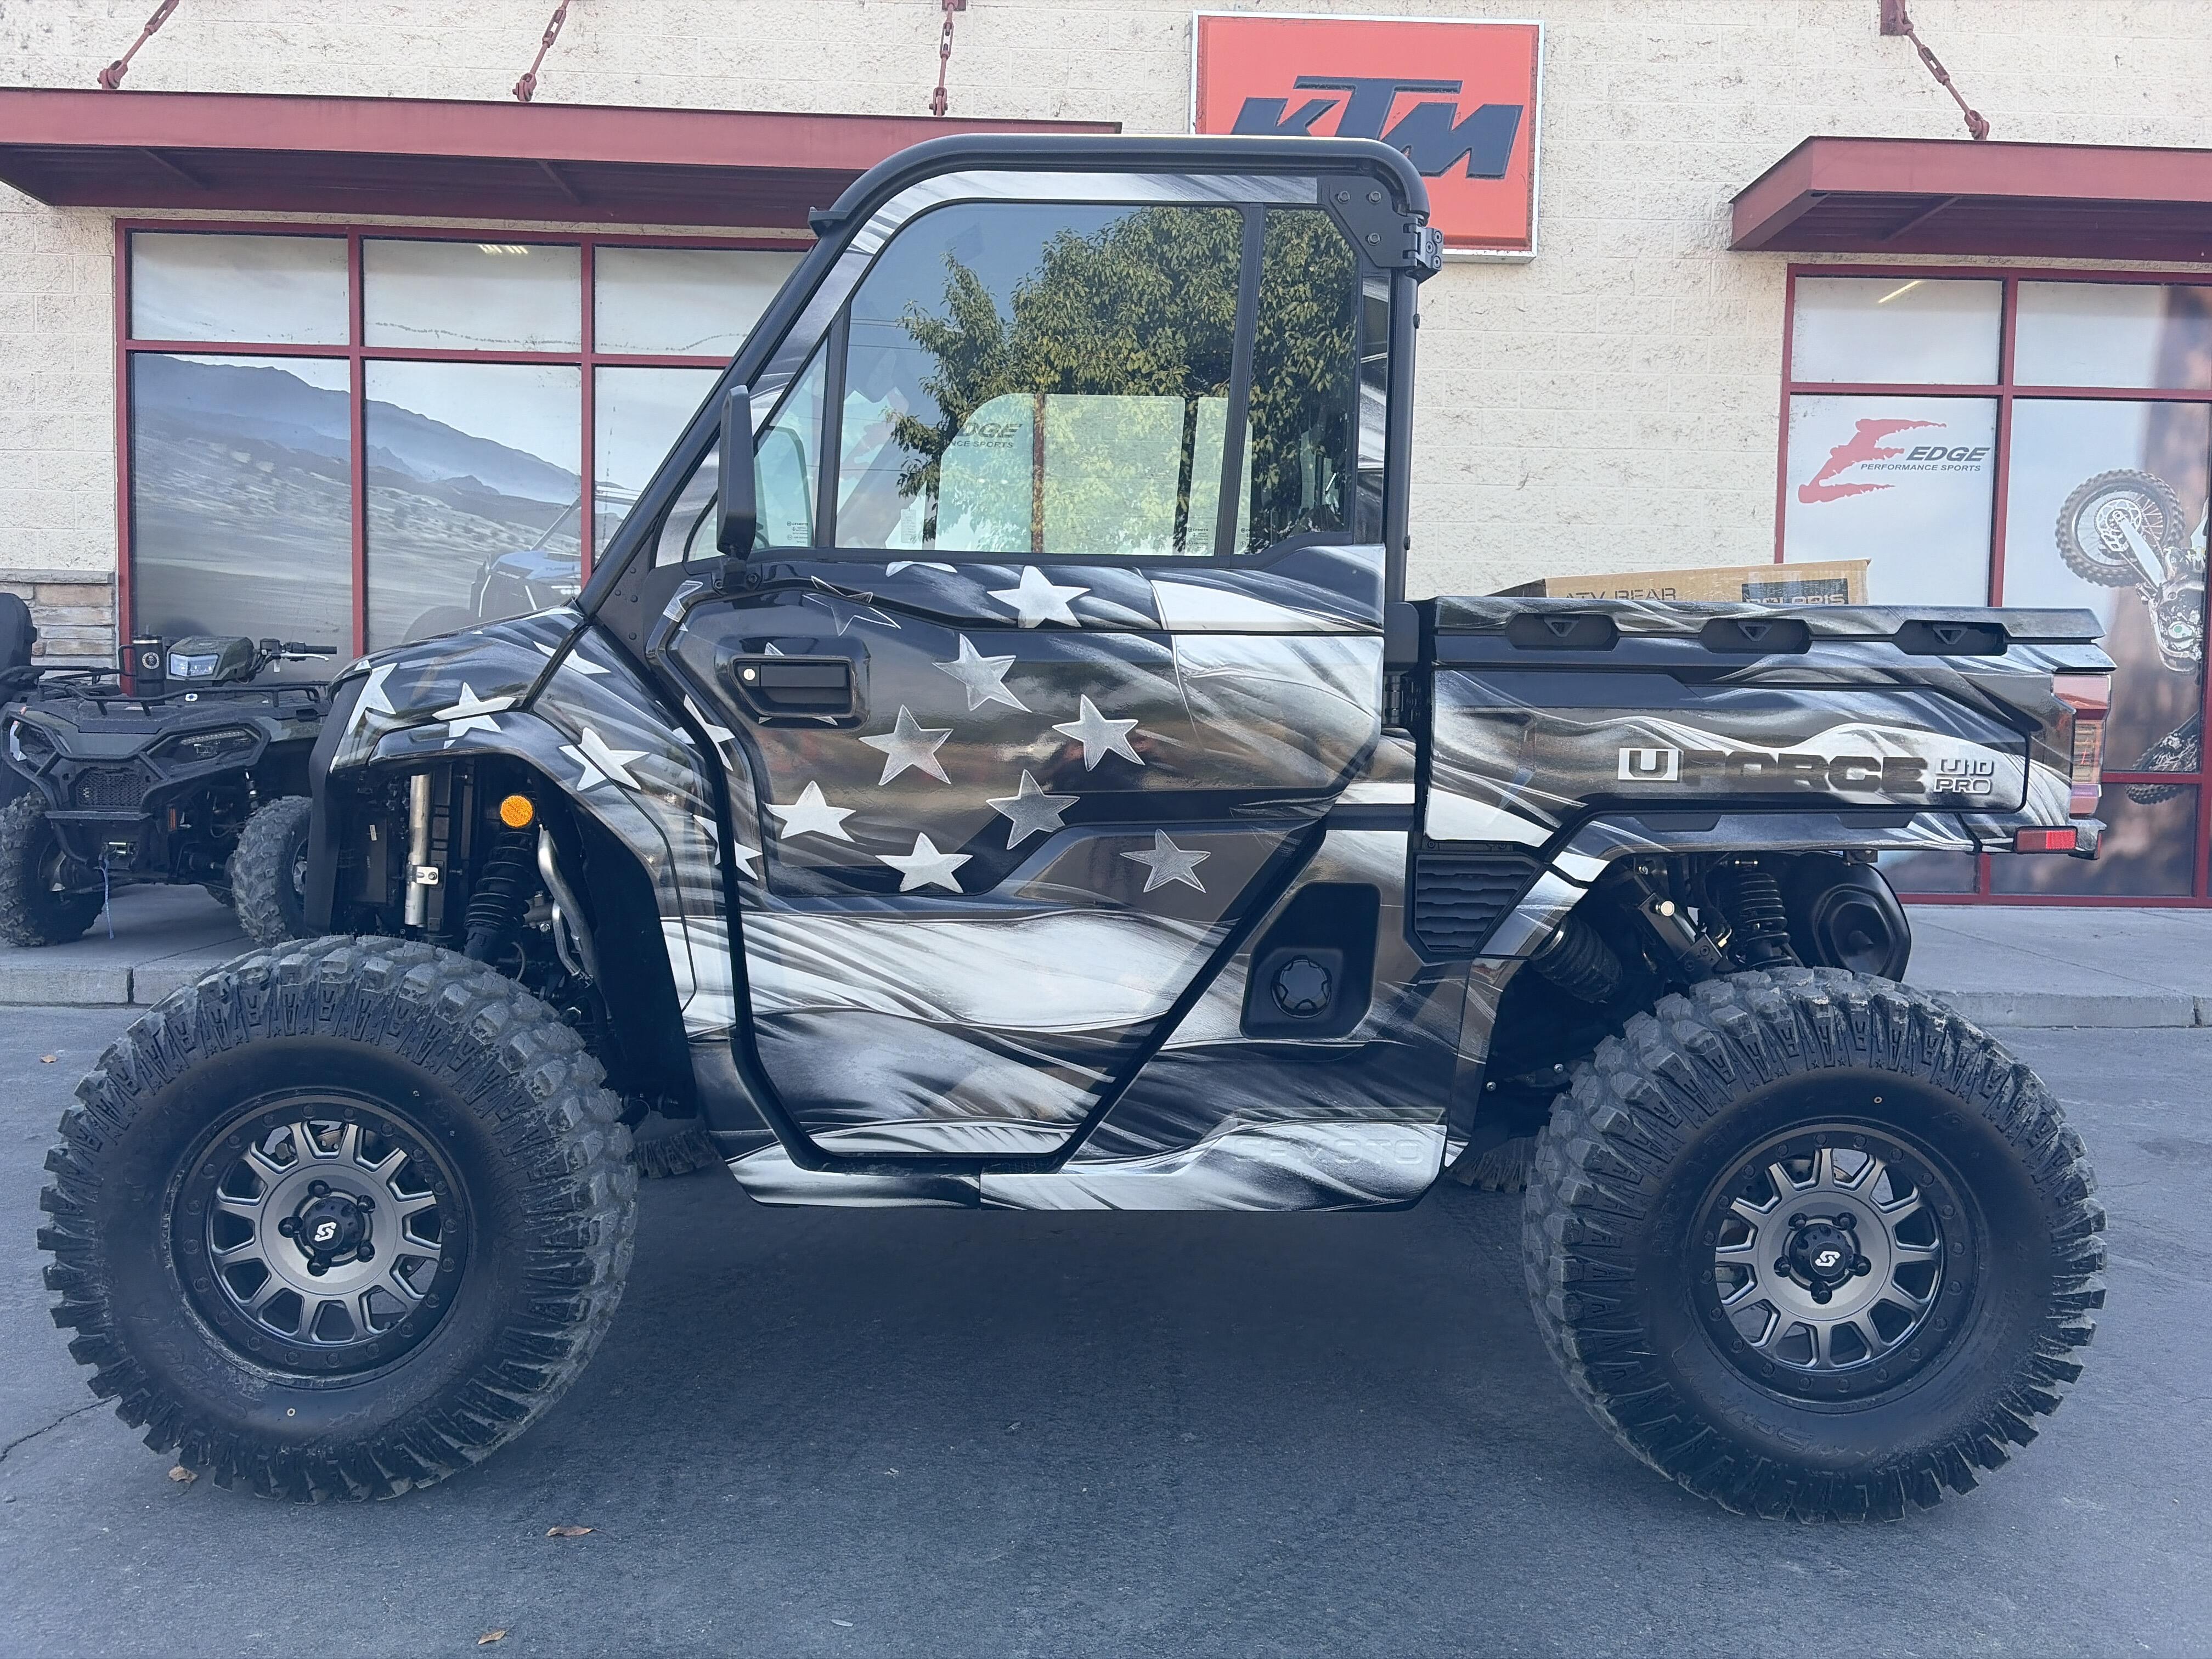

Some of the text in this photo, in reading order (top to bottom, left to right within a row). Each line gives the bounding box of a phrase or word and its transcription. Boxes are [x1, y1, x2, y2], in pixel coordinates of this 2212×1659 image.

[1231, 75, 1523, 179] KTM
[955, 422, 1023, 438] DGE
[1906, 446, 1990, 462] EDGE
[1933, 777, 1993, 795] PRO
